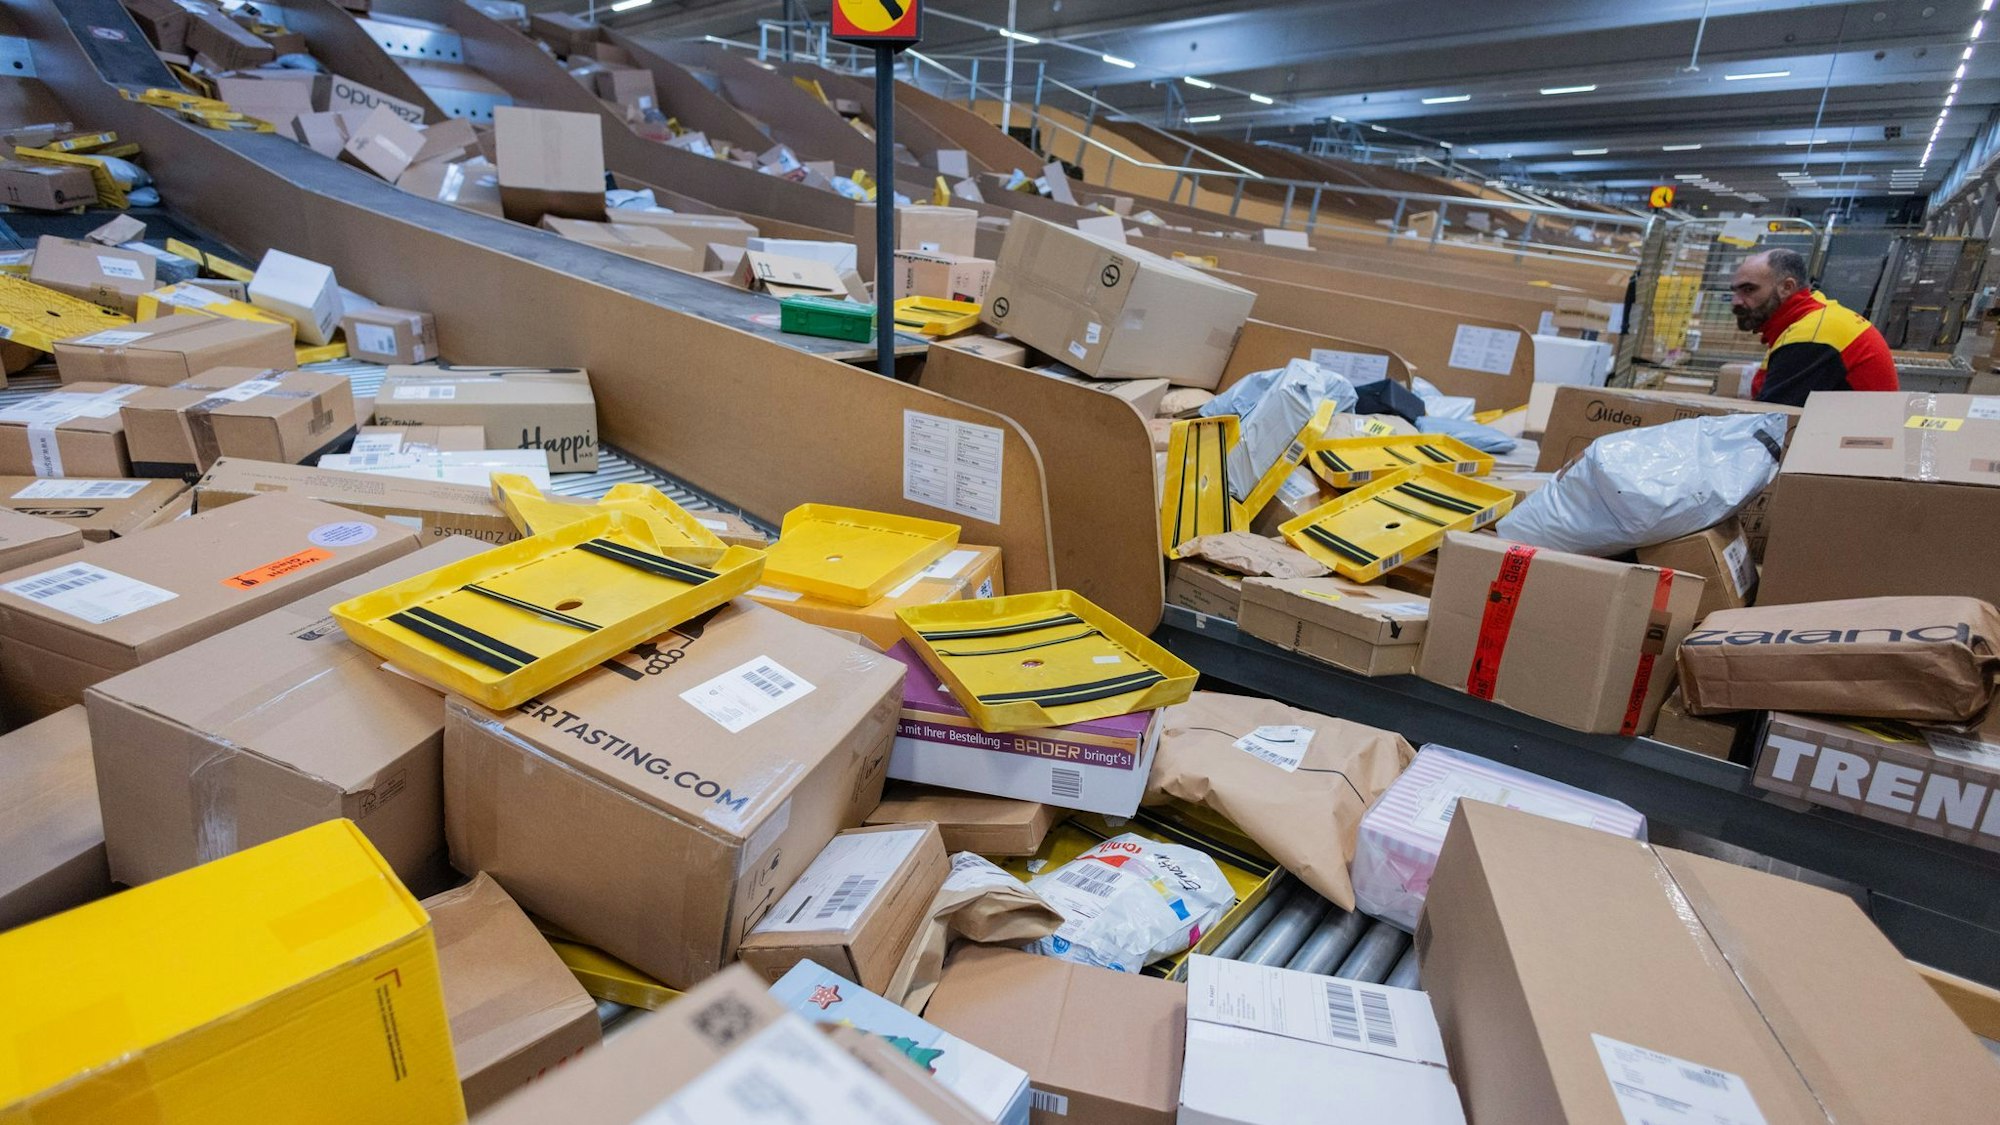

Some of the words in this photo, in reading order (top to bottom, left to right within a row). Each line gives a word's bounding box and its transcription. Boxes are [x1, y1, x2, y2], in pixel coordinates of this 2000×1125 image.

[336, 84, 421, 124] zando
[1585, 400, 1642, 428] Midea
[515, 699, 749, 812] ERTASTING.COM
[905, 724, 921, 736] mit
[924, 726, 946, 739] Ihrer
[949, 730, 1000, 749] Bestellung
[1014, 738, 1081, 760] BADER
